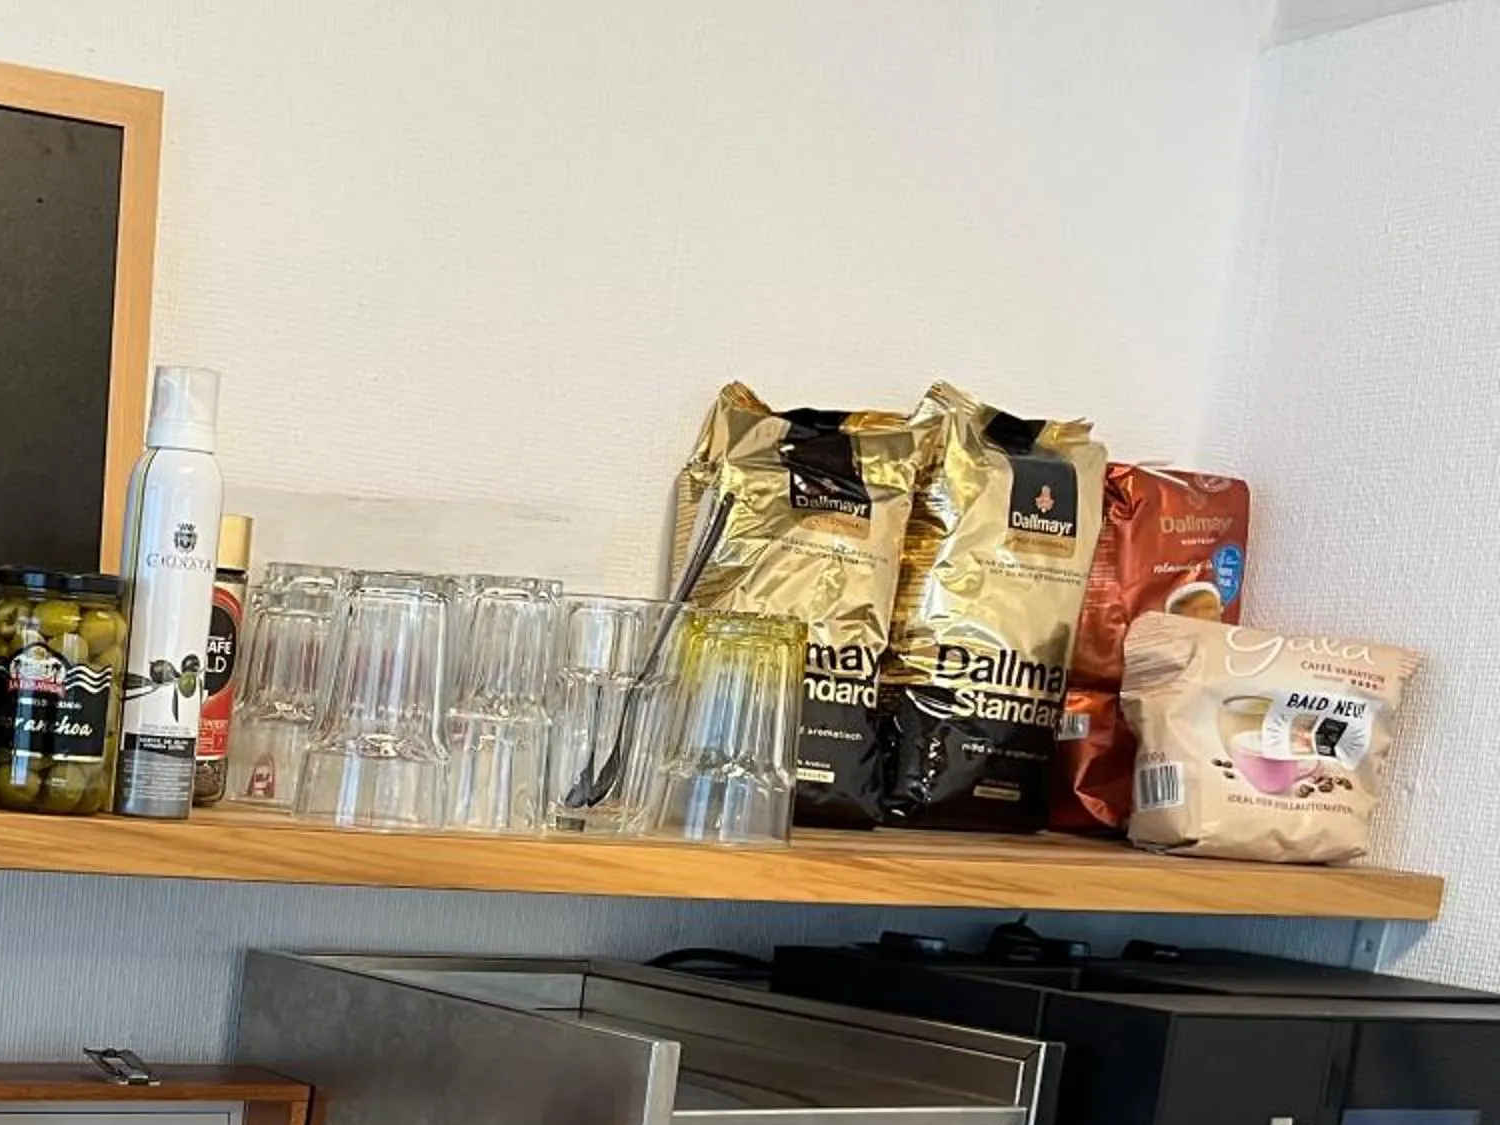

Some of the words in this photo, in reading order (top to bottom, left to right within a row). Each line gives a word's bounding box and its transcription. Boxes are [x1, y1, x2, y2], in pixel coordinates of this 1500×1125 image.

[795, 494, 869, 517] Dallmayr
[1011, 510, 1073, 537] Dallmayr
[1334, 667, 1386, 684] VARIATION
[1286, 692, 1330, 712] BALD
[1332, 700, 1367, 720] NEU!
[807, 727, 863, 741] aromatisch
